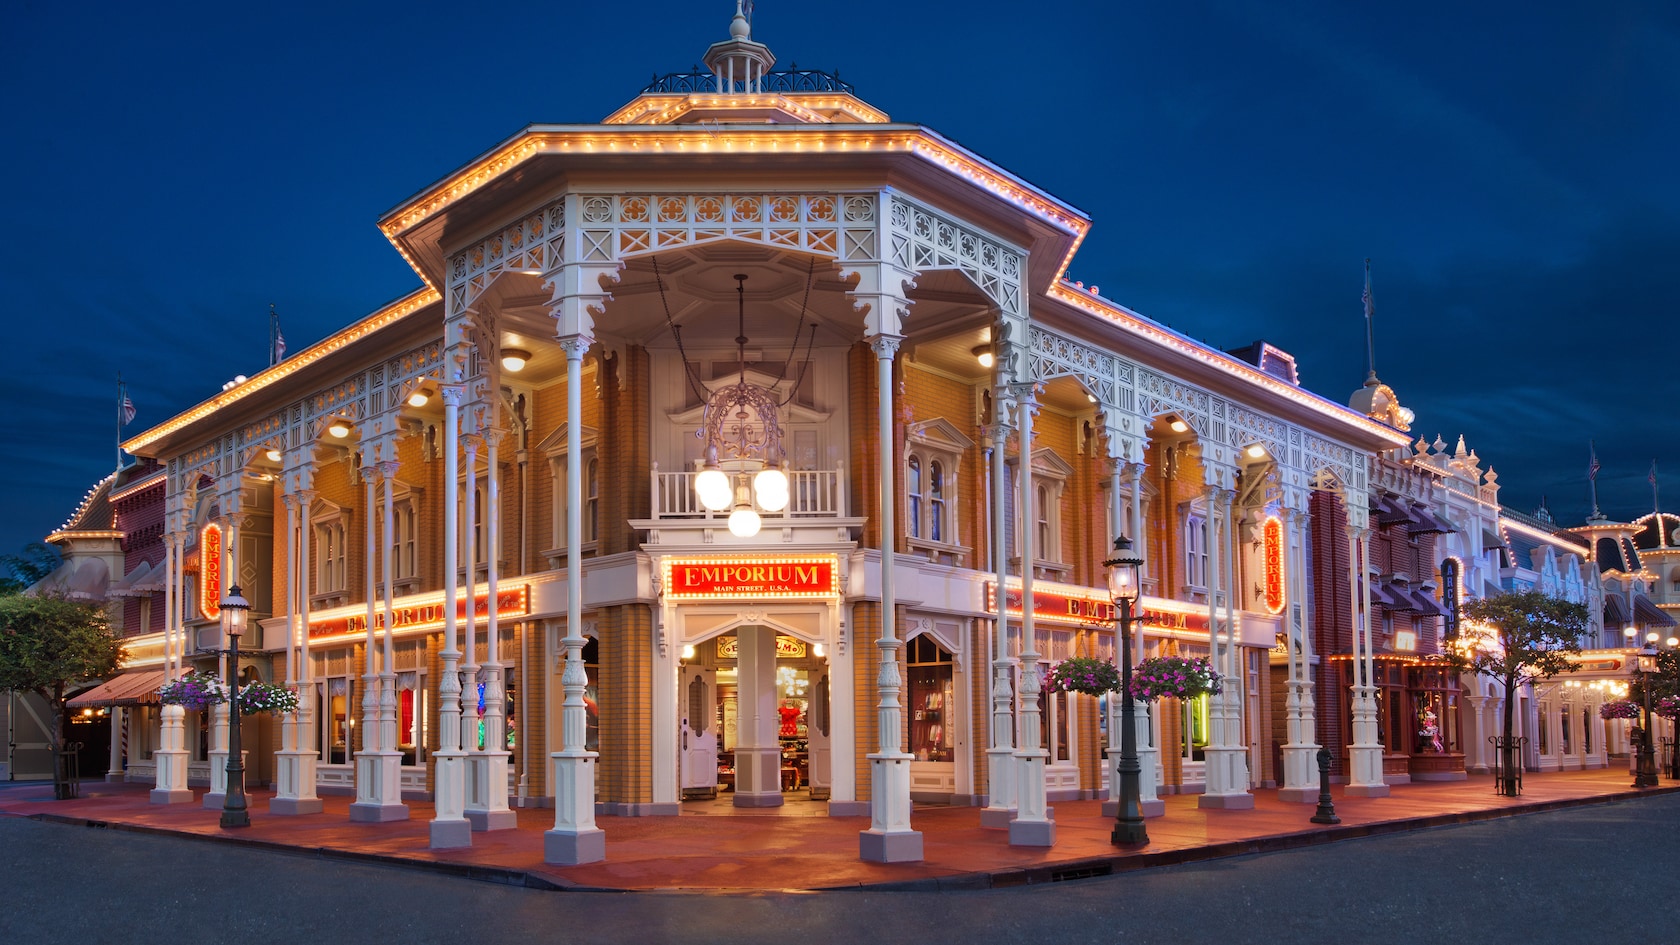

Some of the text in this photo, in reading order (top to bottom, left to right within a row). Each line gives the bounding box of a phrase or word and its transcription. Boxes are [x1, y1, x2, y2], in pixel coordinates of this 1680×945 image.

[207, 534, 220, 608] EMPORIUM
[684, 566, 818, 586] EMPORIUM
[1267, 527, 1281, 602] EMPORIUM
[1447, 564, 1455, 635] ARCADE
[346, 604, 446, 633] EMPORIU
